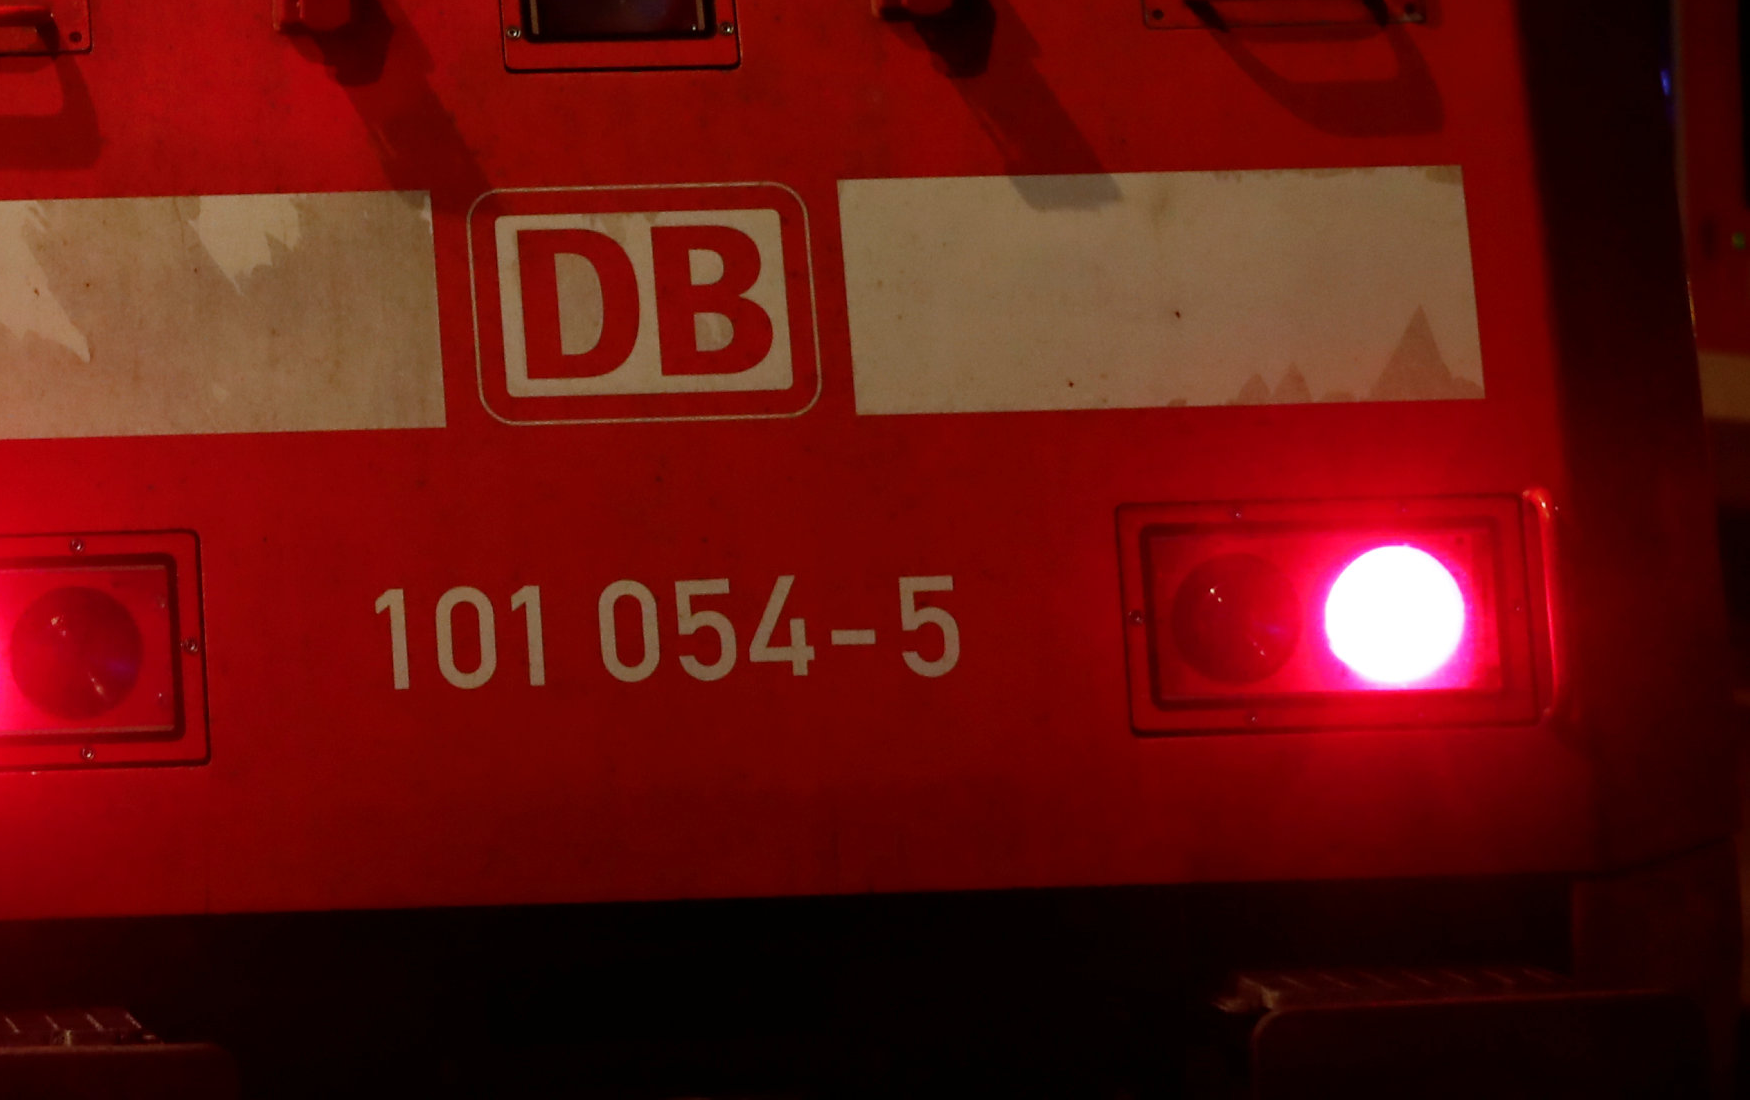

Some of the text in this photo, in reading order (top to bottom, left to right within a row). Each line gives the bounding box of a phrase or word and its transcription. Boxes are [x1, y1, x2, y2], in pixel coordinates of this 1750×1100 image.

[515, 223, 774, 381] DB
[374, 574, 961, 690] 101 054-5
